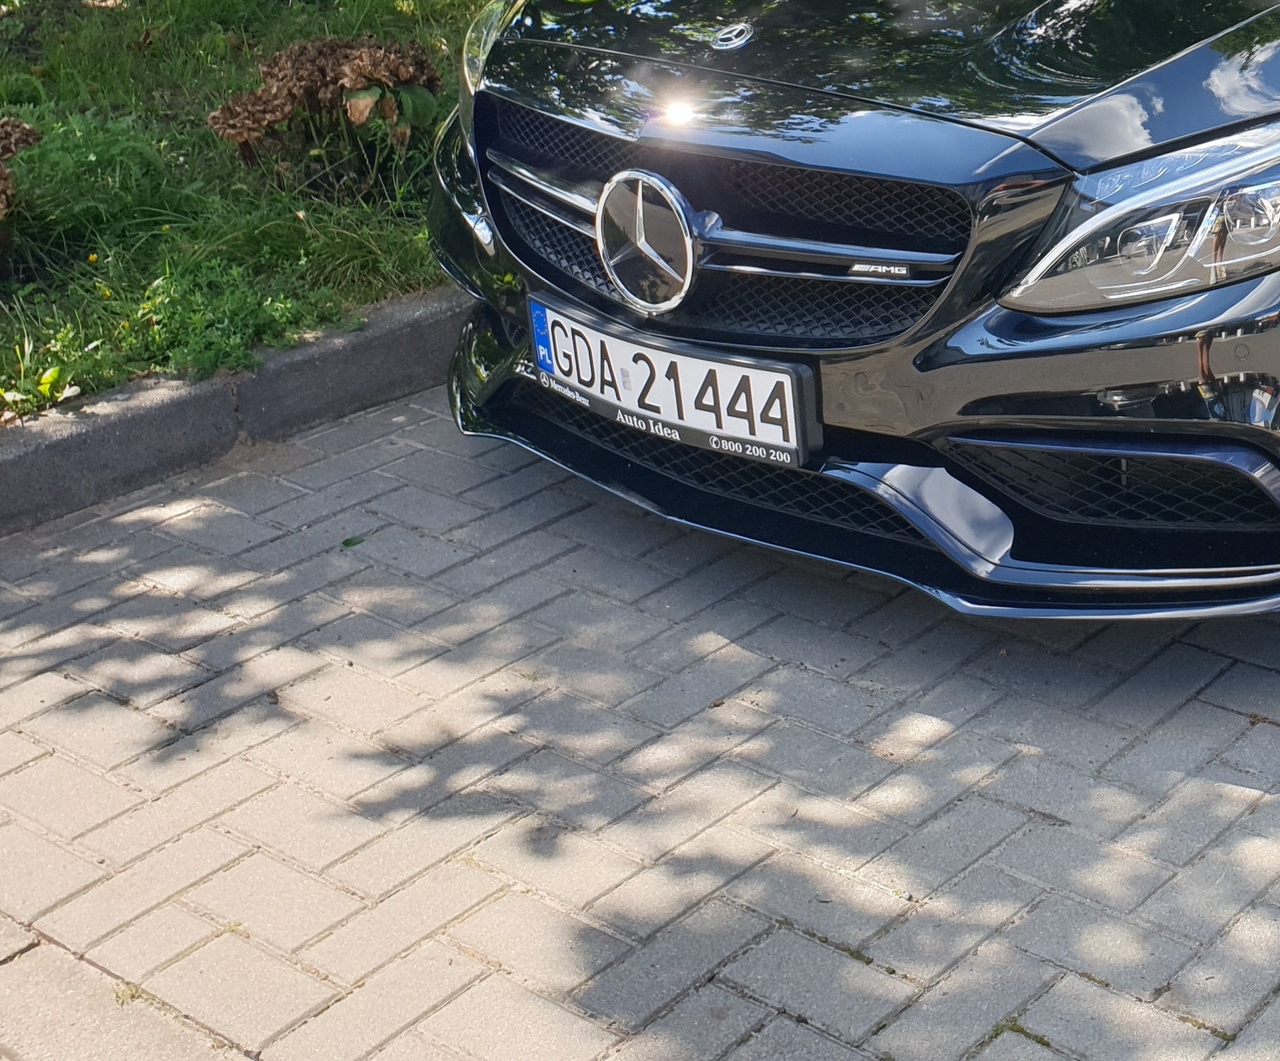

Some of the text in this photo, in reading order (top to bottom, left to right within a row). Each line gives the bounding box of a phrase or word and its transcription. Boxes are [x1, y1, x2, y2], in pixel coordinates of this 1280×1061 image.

[869, 265, 907, 275] AMG
[538, 344, 552, 365] PL
[551, 319, 790, 443] GDA 21444
[616, 408, 681, 441] Auto Idea
[721, 439, 791, 464] 800 200 200
